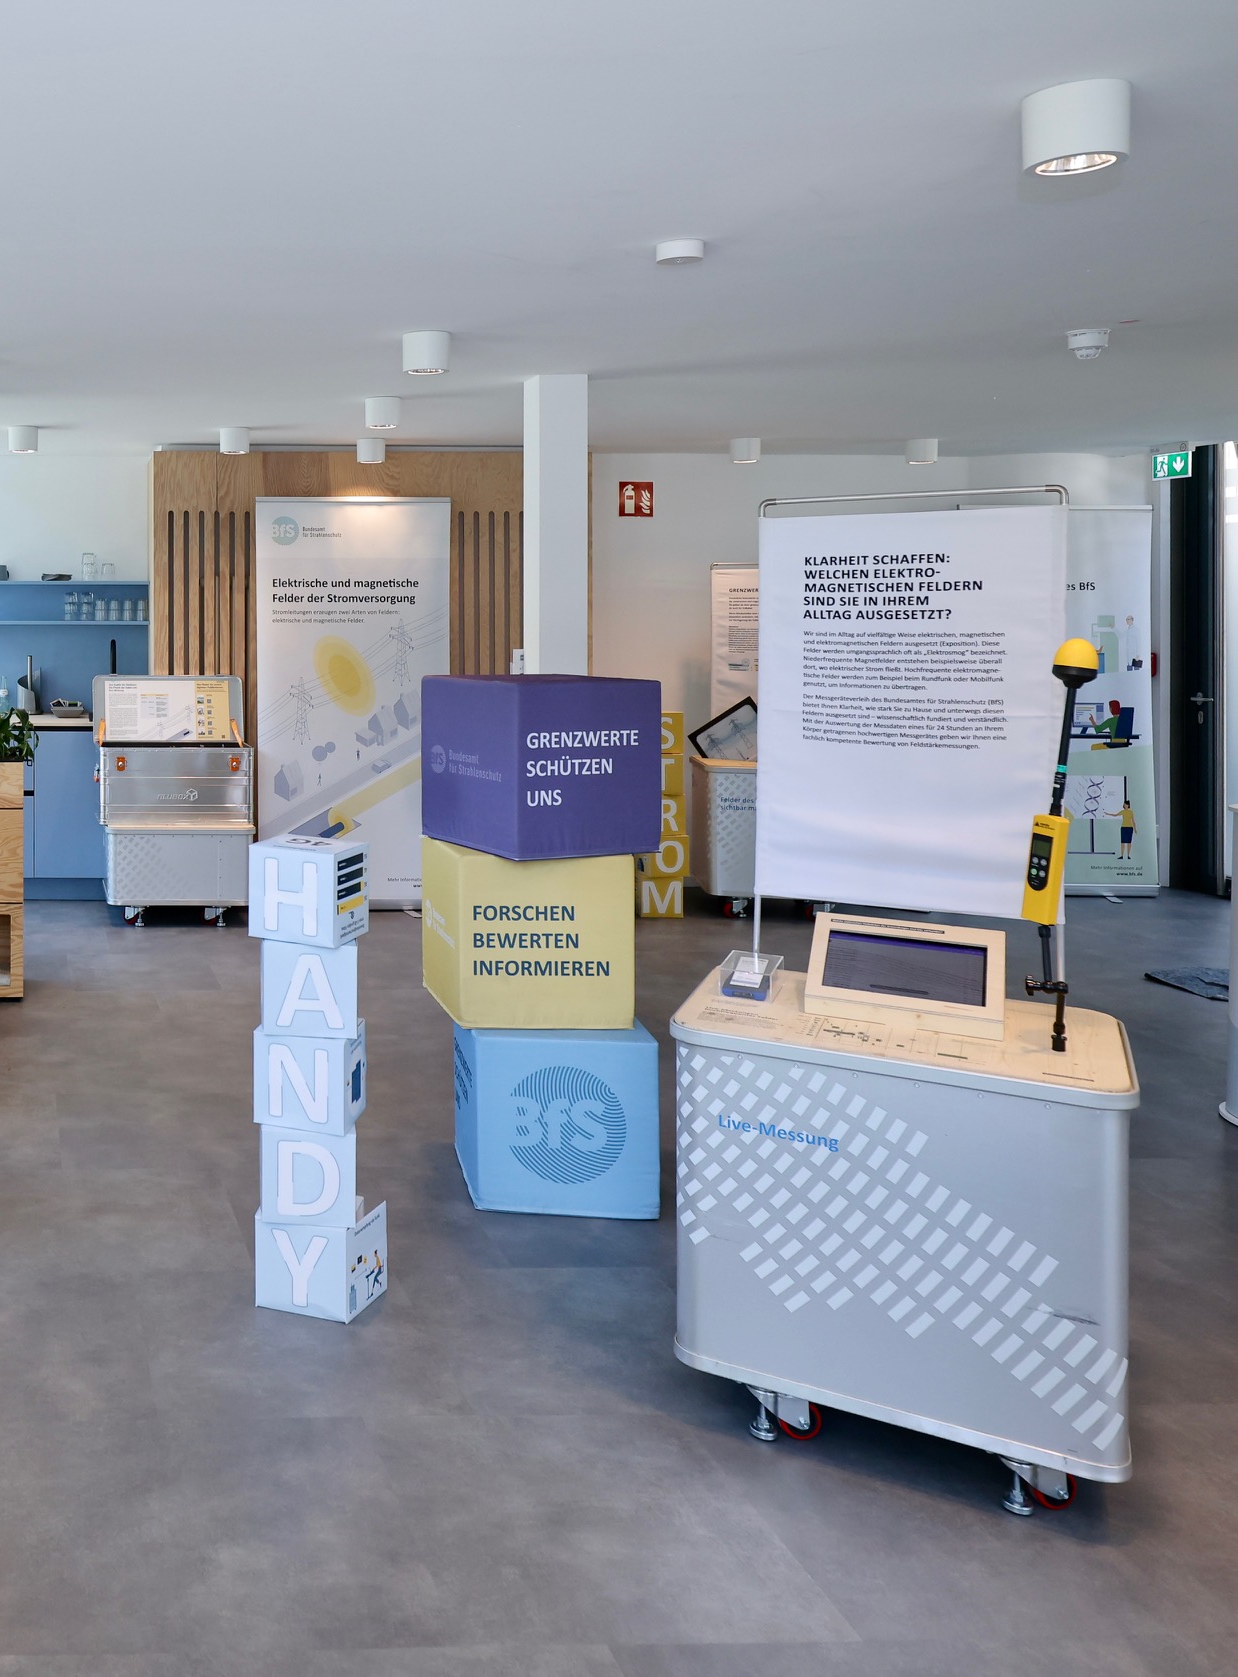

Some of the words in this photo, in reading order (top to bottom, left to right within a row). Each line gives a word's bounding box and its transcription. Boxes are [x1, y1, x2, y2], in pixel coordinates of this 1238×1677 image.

[271, 524, 295, 538] BfS
[804, 555, 869, 566] KLARHEIT
[873, 553, 950, 565] SCHAFFEN:
[804, 569, 869, 580] WELCHEN
[874, 567, 941, 579] ELEKTRO-
[272, 578, 328, 588] Elektrische
[331, 578, 350, 588] und
[354, 578, 419, 590] magnetische
[804, 582, 913, 593] MAGNETISCHEN
[919, 580, 983, 592] FELDERN
[1080, 582, 1095, 590] BfS
[272, 594, 304, 603] Felder
[307, 594, 324, 603] der
[327, 594, 416, 605] Stromversorgung
[803, 596, 835, 606] SIND
[839, 596, 859, 606] SIE
[864, 596, 878, 606] IN
[882, 596, 929, 606] IHREM
[803, 609, 852, 620] ALLTAG
[856, 609, 952, 620] AUSGESETZT?
[526, 729, 639, 749] GRENZWERTE
[449, 749, 479, 764] Bundesamt
[459, 764, 502, 782] Strahlenschutz
[526, 755, 613, 777] SCHÜTZEN
[526, 789, 562, 806] UNS
[472, 905, 575, 922] FORSCHEN
[473, 933, 579, 949] BEWERTEN
[473, 960, 609, 976] INFORMIEREN
[510, 1098, 608, 1151] BfS
[718, 1114, 839, 1152] Live-Messung
